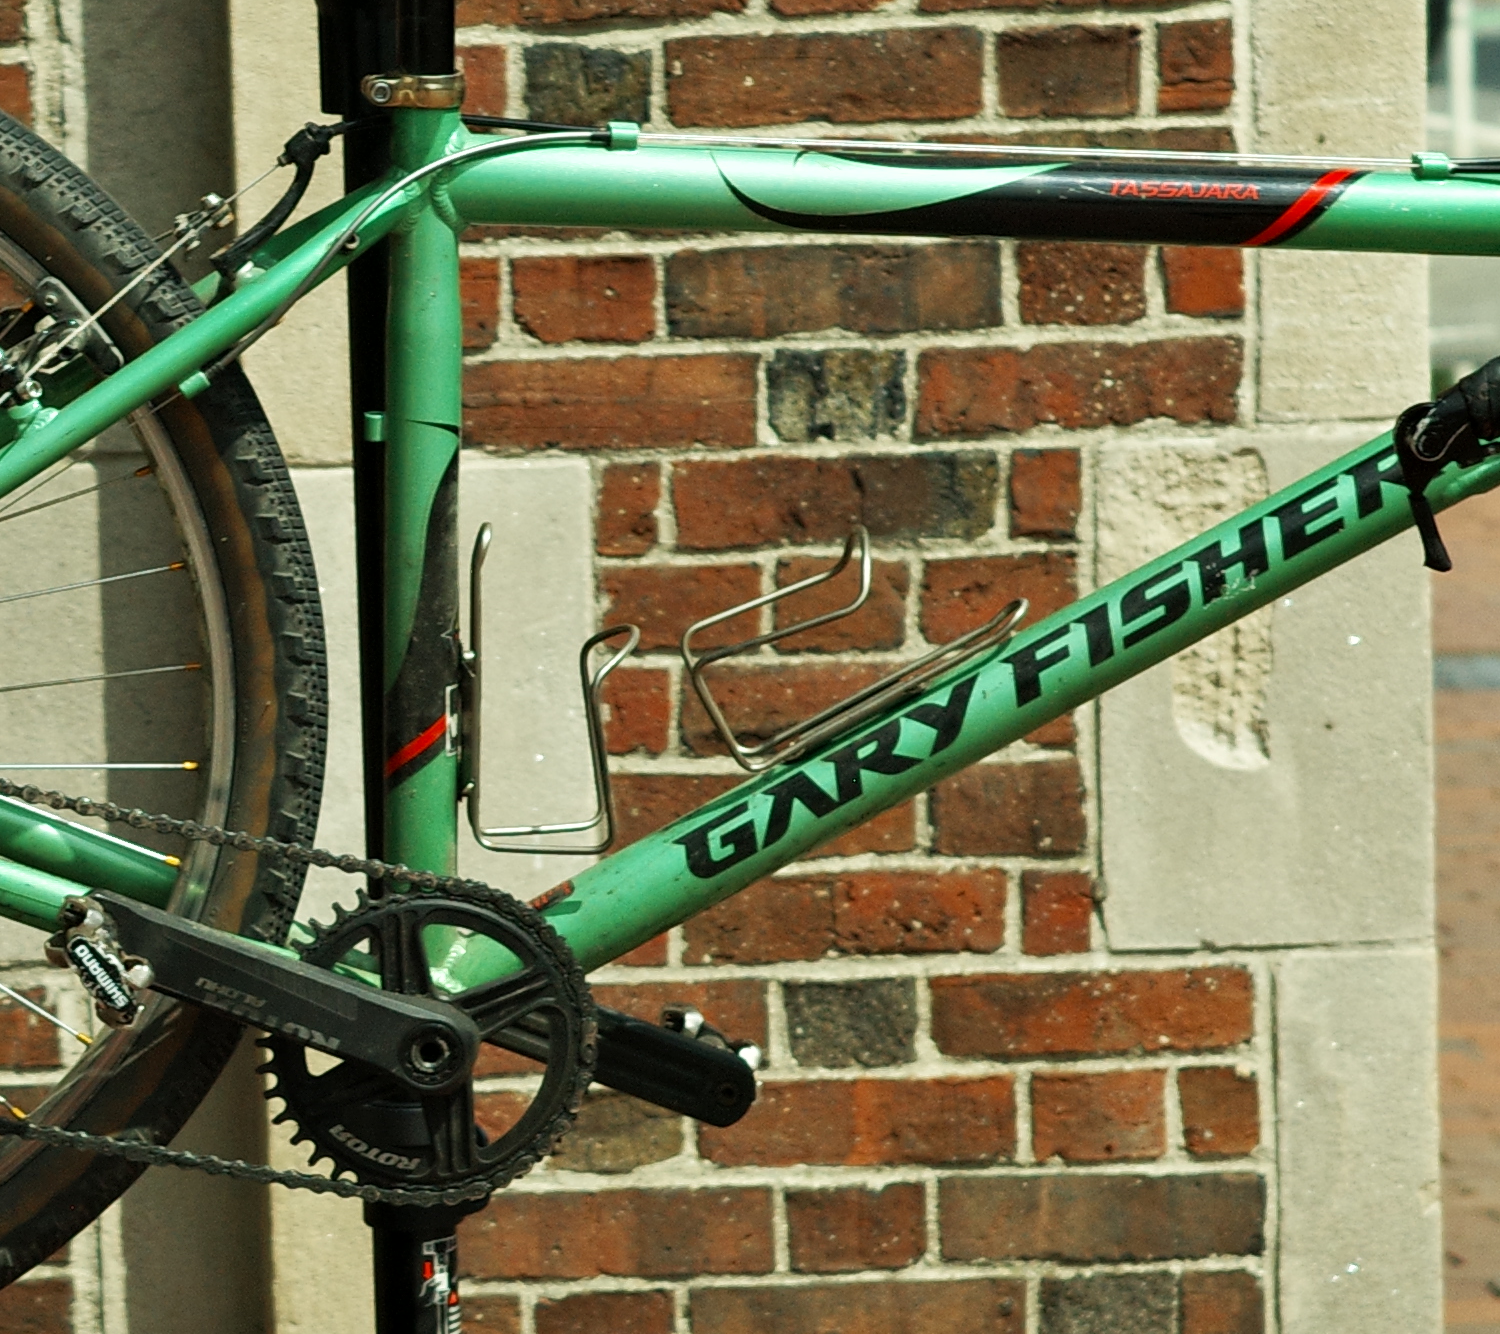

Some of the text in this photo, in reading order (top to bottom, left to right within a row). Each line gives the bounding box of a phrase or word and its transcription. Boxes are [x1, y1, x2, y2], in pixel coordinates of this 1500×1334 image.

[1109, 179, 1260, 202] TASSAJARA
[672, 443, 1410, 880] GARY FISHER
[74, 944, 129, 1008] SHIMANO
[328, 1124, 421, 1170] ROTOR
